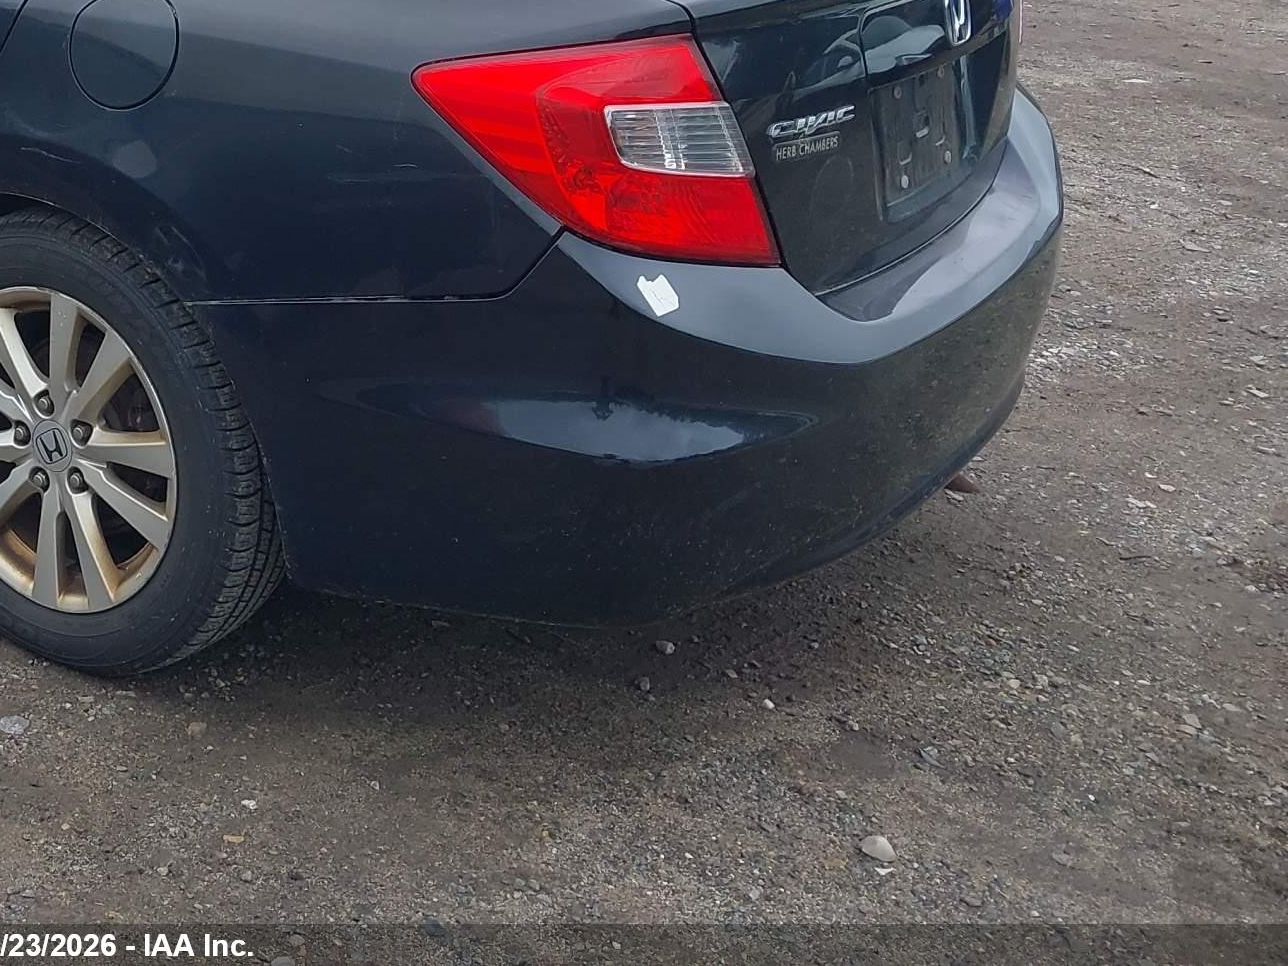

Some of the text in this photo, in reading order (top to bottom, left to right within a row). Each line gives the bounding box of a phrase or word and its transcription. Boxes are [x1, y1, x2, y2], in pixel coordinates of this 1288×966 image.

[768, 105, 855, 138] CIVIC
[776, 136, 839, 161] HERB CHAMBERS
